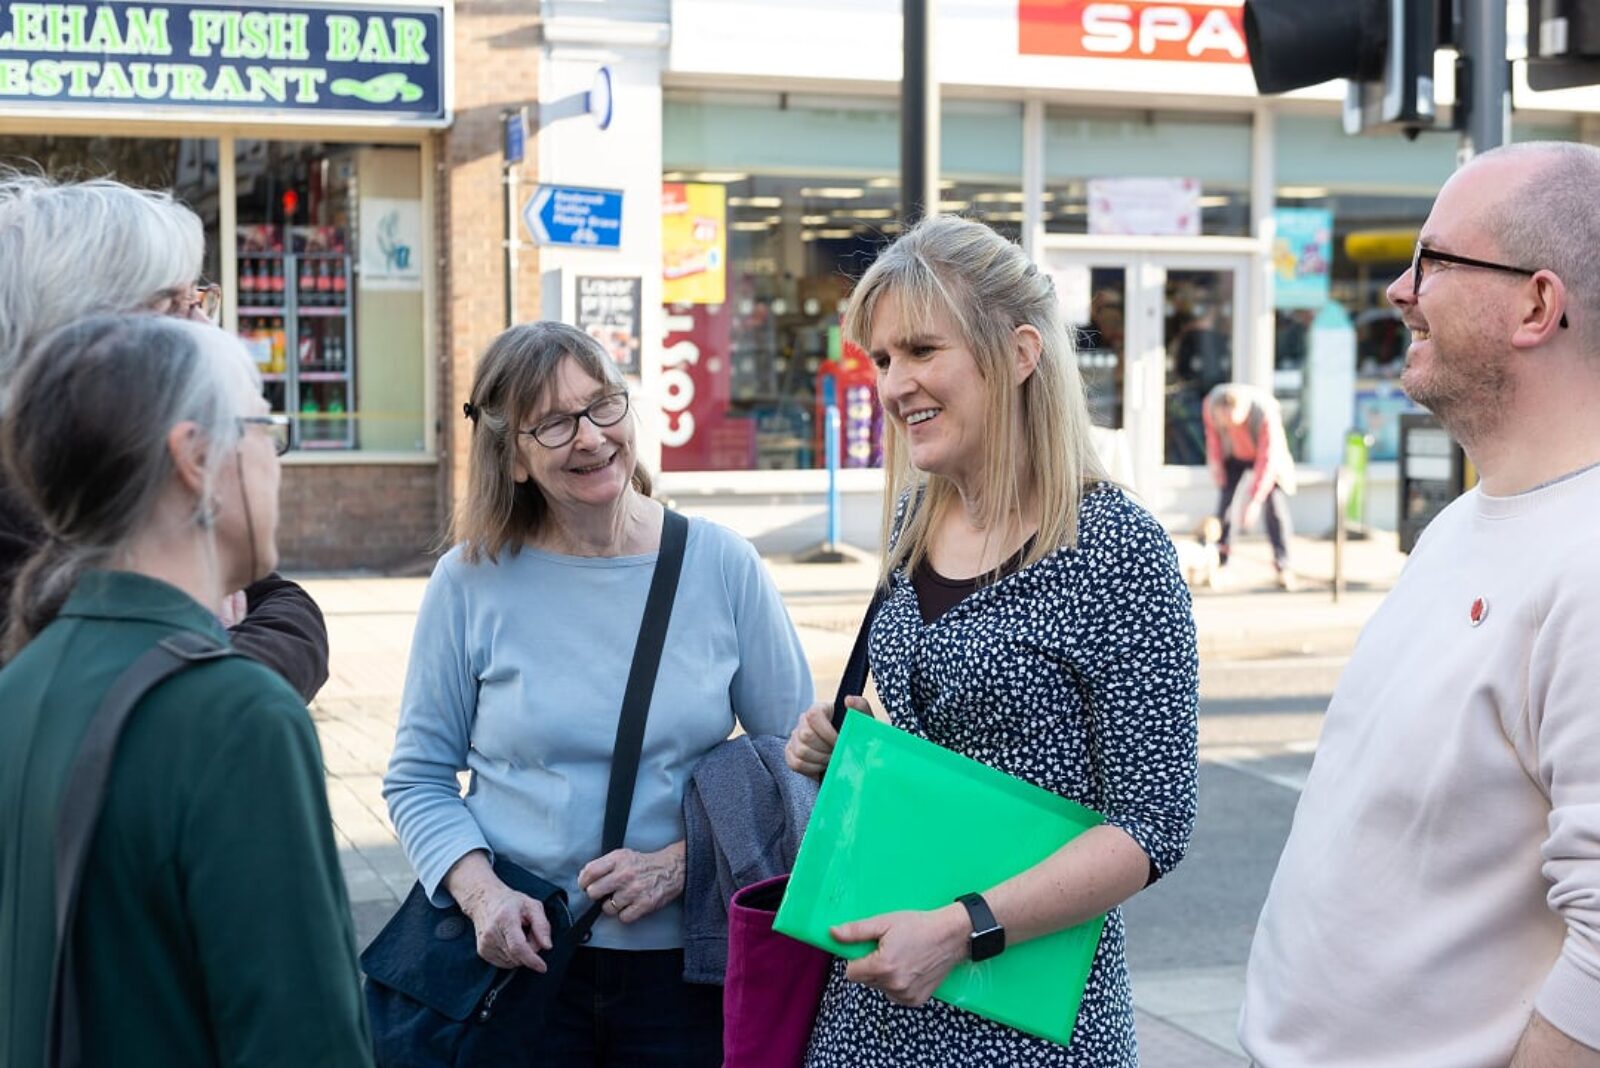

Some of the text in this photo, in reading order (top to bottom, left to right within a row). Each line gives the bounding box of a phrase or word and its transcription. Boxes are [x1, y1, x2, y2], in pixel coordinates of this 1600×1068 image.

[0, 2, 430, 64] EHAM FISH BAR
[1081, 3, 1246, 58] SPA
[0, 58, 327, 103] ESTAURANT
[661, 302, 700, 448] COST
